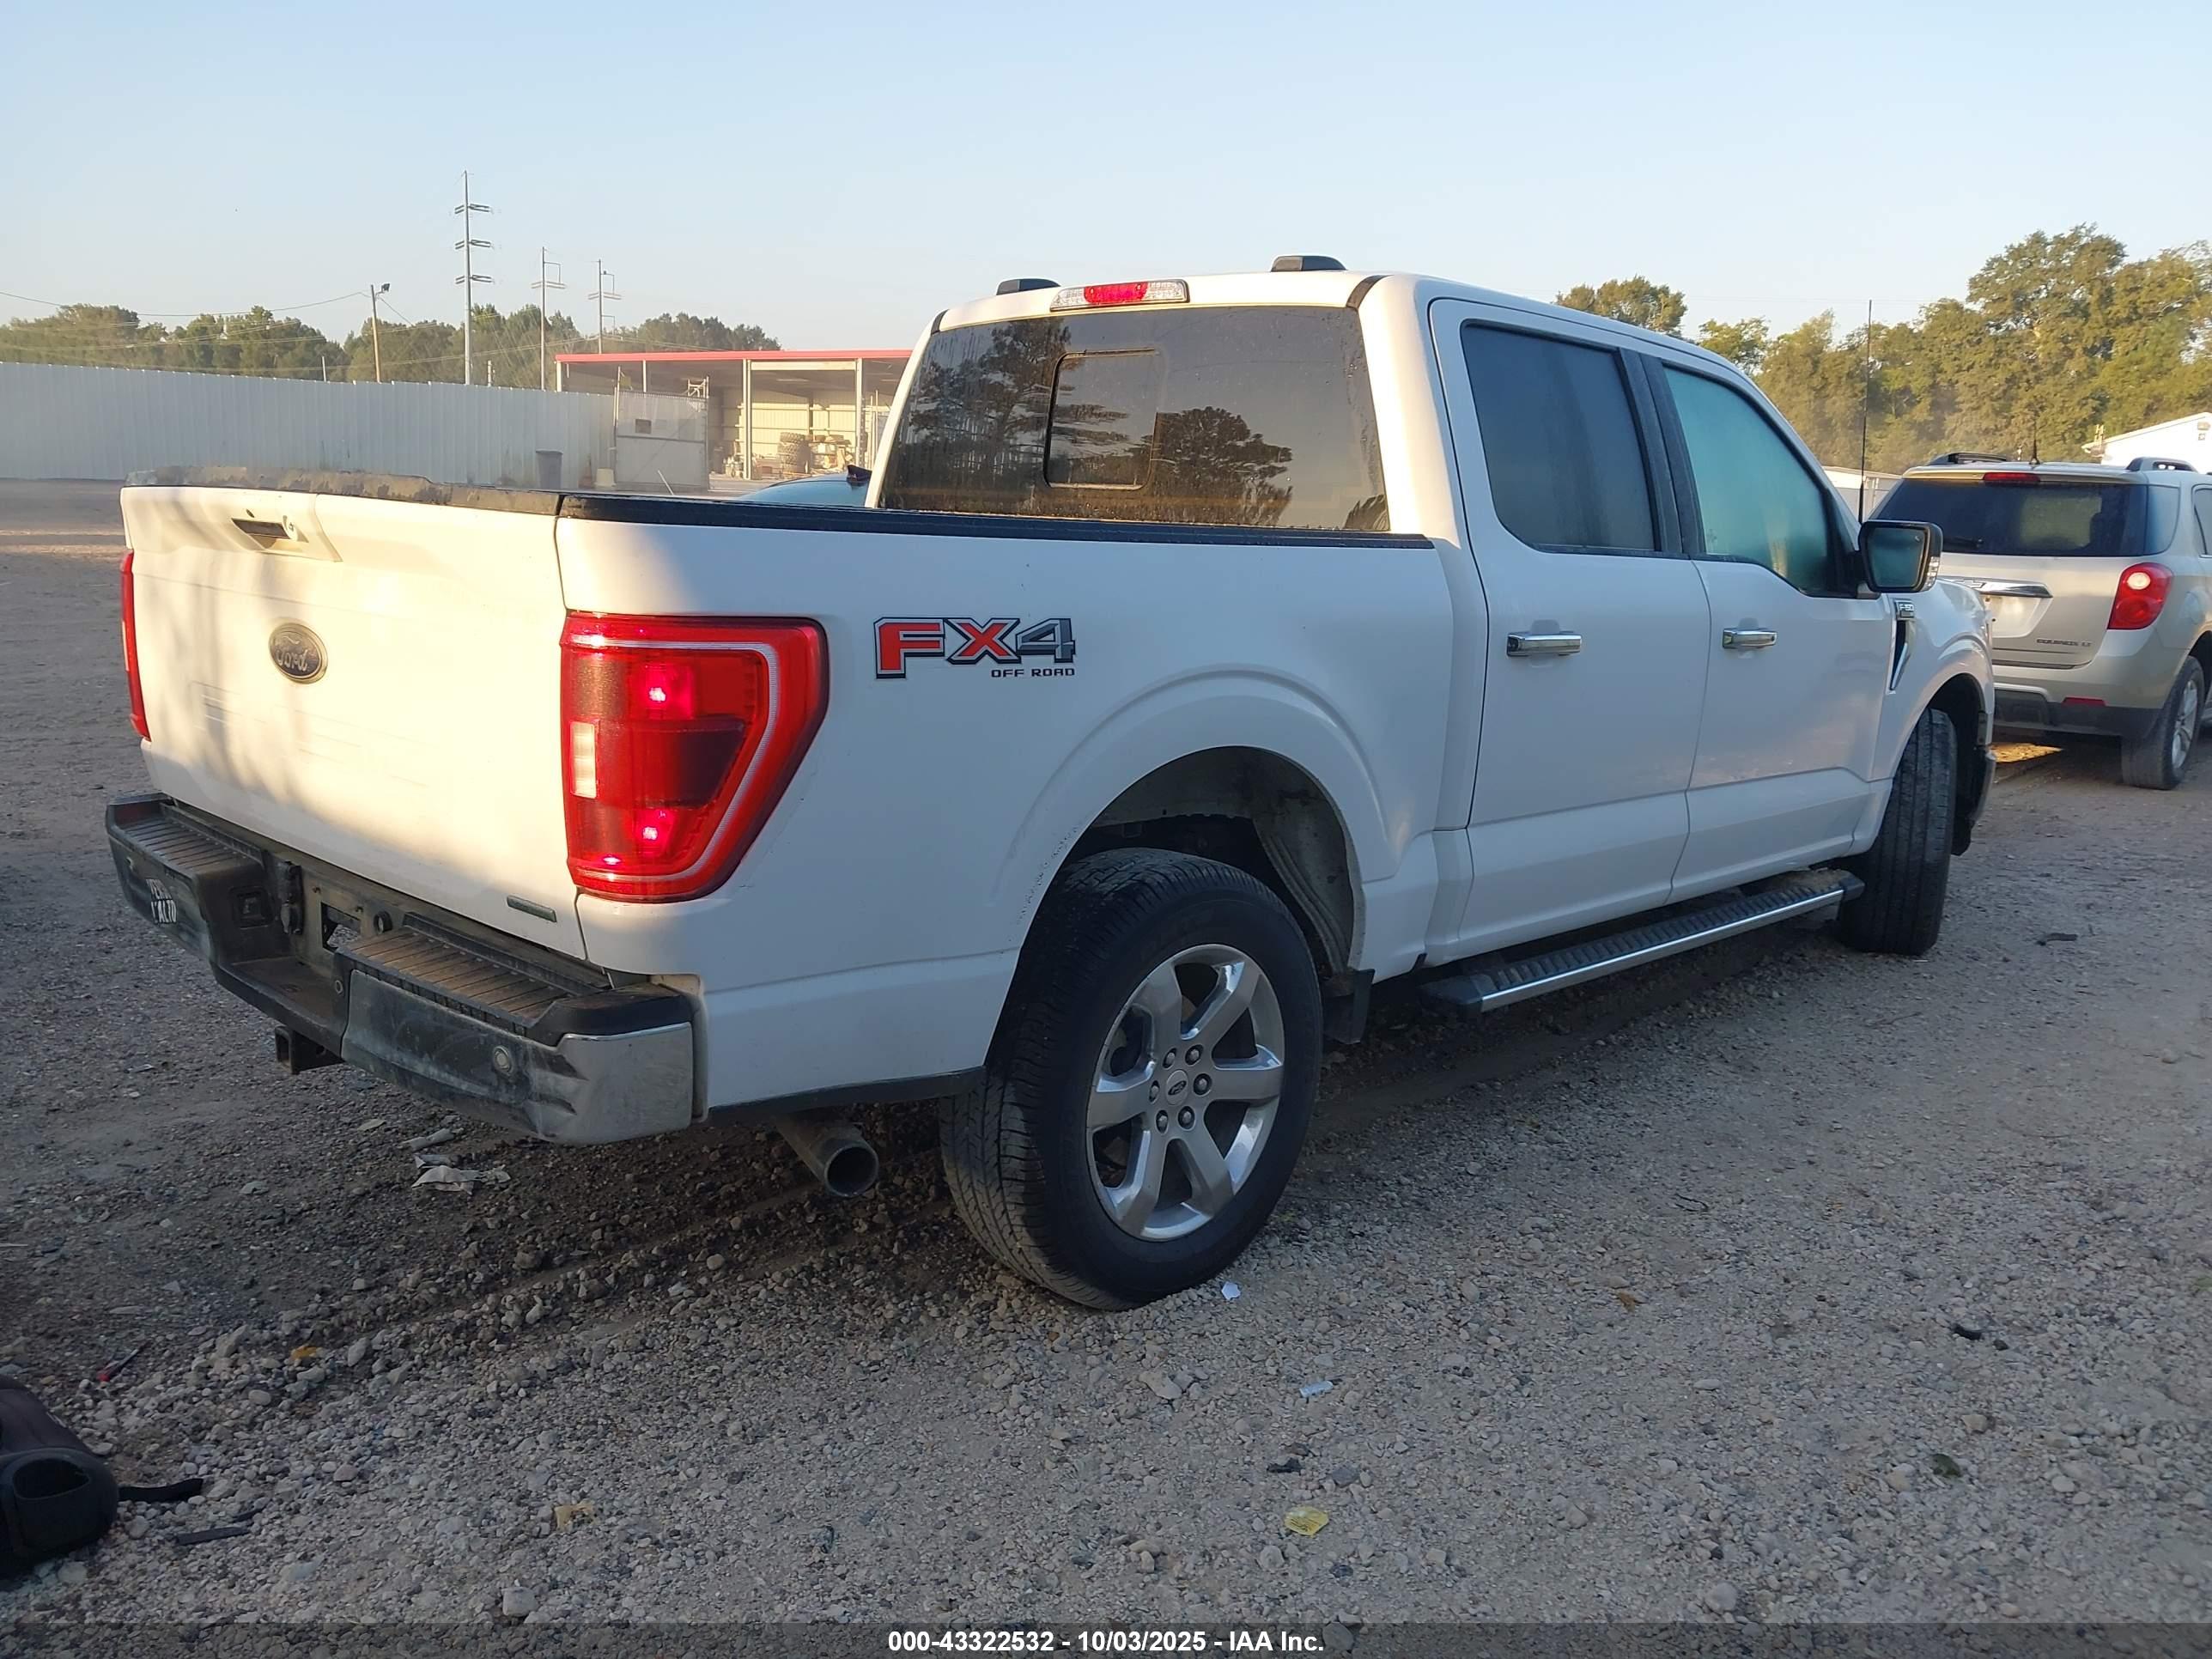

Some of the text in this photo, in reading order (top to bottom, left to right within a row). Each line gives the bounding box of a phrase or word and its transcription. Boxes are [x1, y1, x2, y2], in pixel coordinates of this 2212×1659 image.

[873, 617, 1075, 678] FX4
[991, 668, 1075, 678] OFF ROAD
